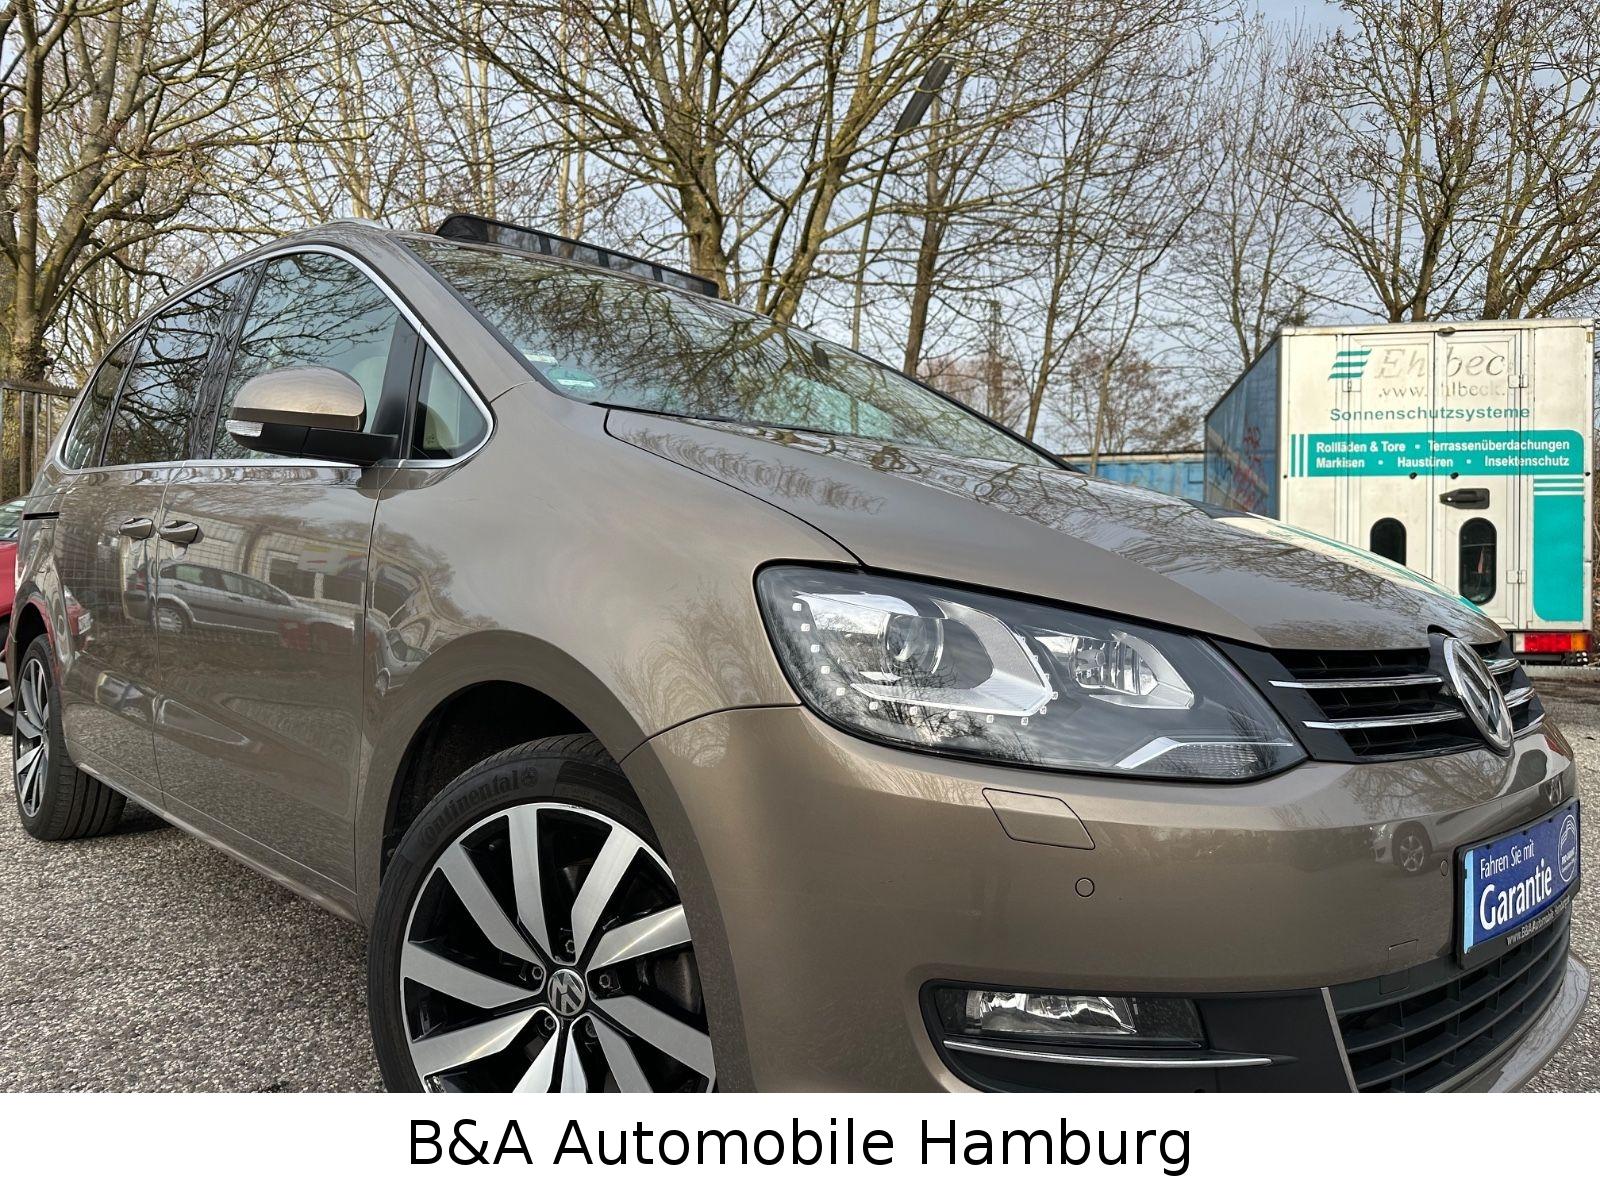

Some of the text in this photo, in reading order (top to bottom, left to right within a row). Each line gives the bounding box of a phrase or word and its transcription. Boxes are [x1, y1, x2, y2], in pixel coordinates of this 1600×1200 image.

[1330, 406, 1530, 423] Sonnenschutzsysteme
[1316, 438, 1570, 453] Rollläden & Tore Terrassenüberdachungen
[1316, 455, 1570, 469] Markisen Haustüren Insektenschutz
[417, 769, 520, 848] Continental
[1480, 854, 1509, 880] Fahren
[1510, 844, 1523, 867] Sie
[1523, 838, 1535, 860] mit
[1479, 858, 1553, 931] Garantie
